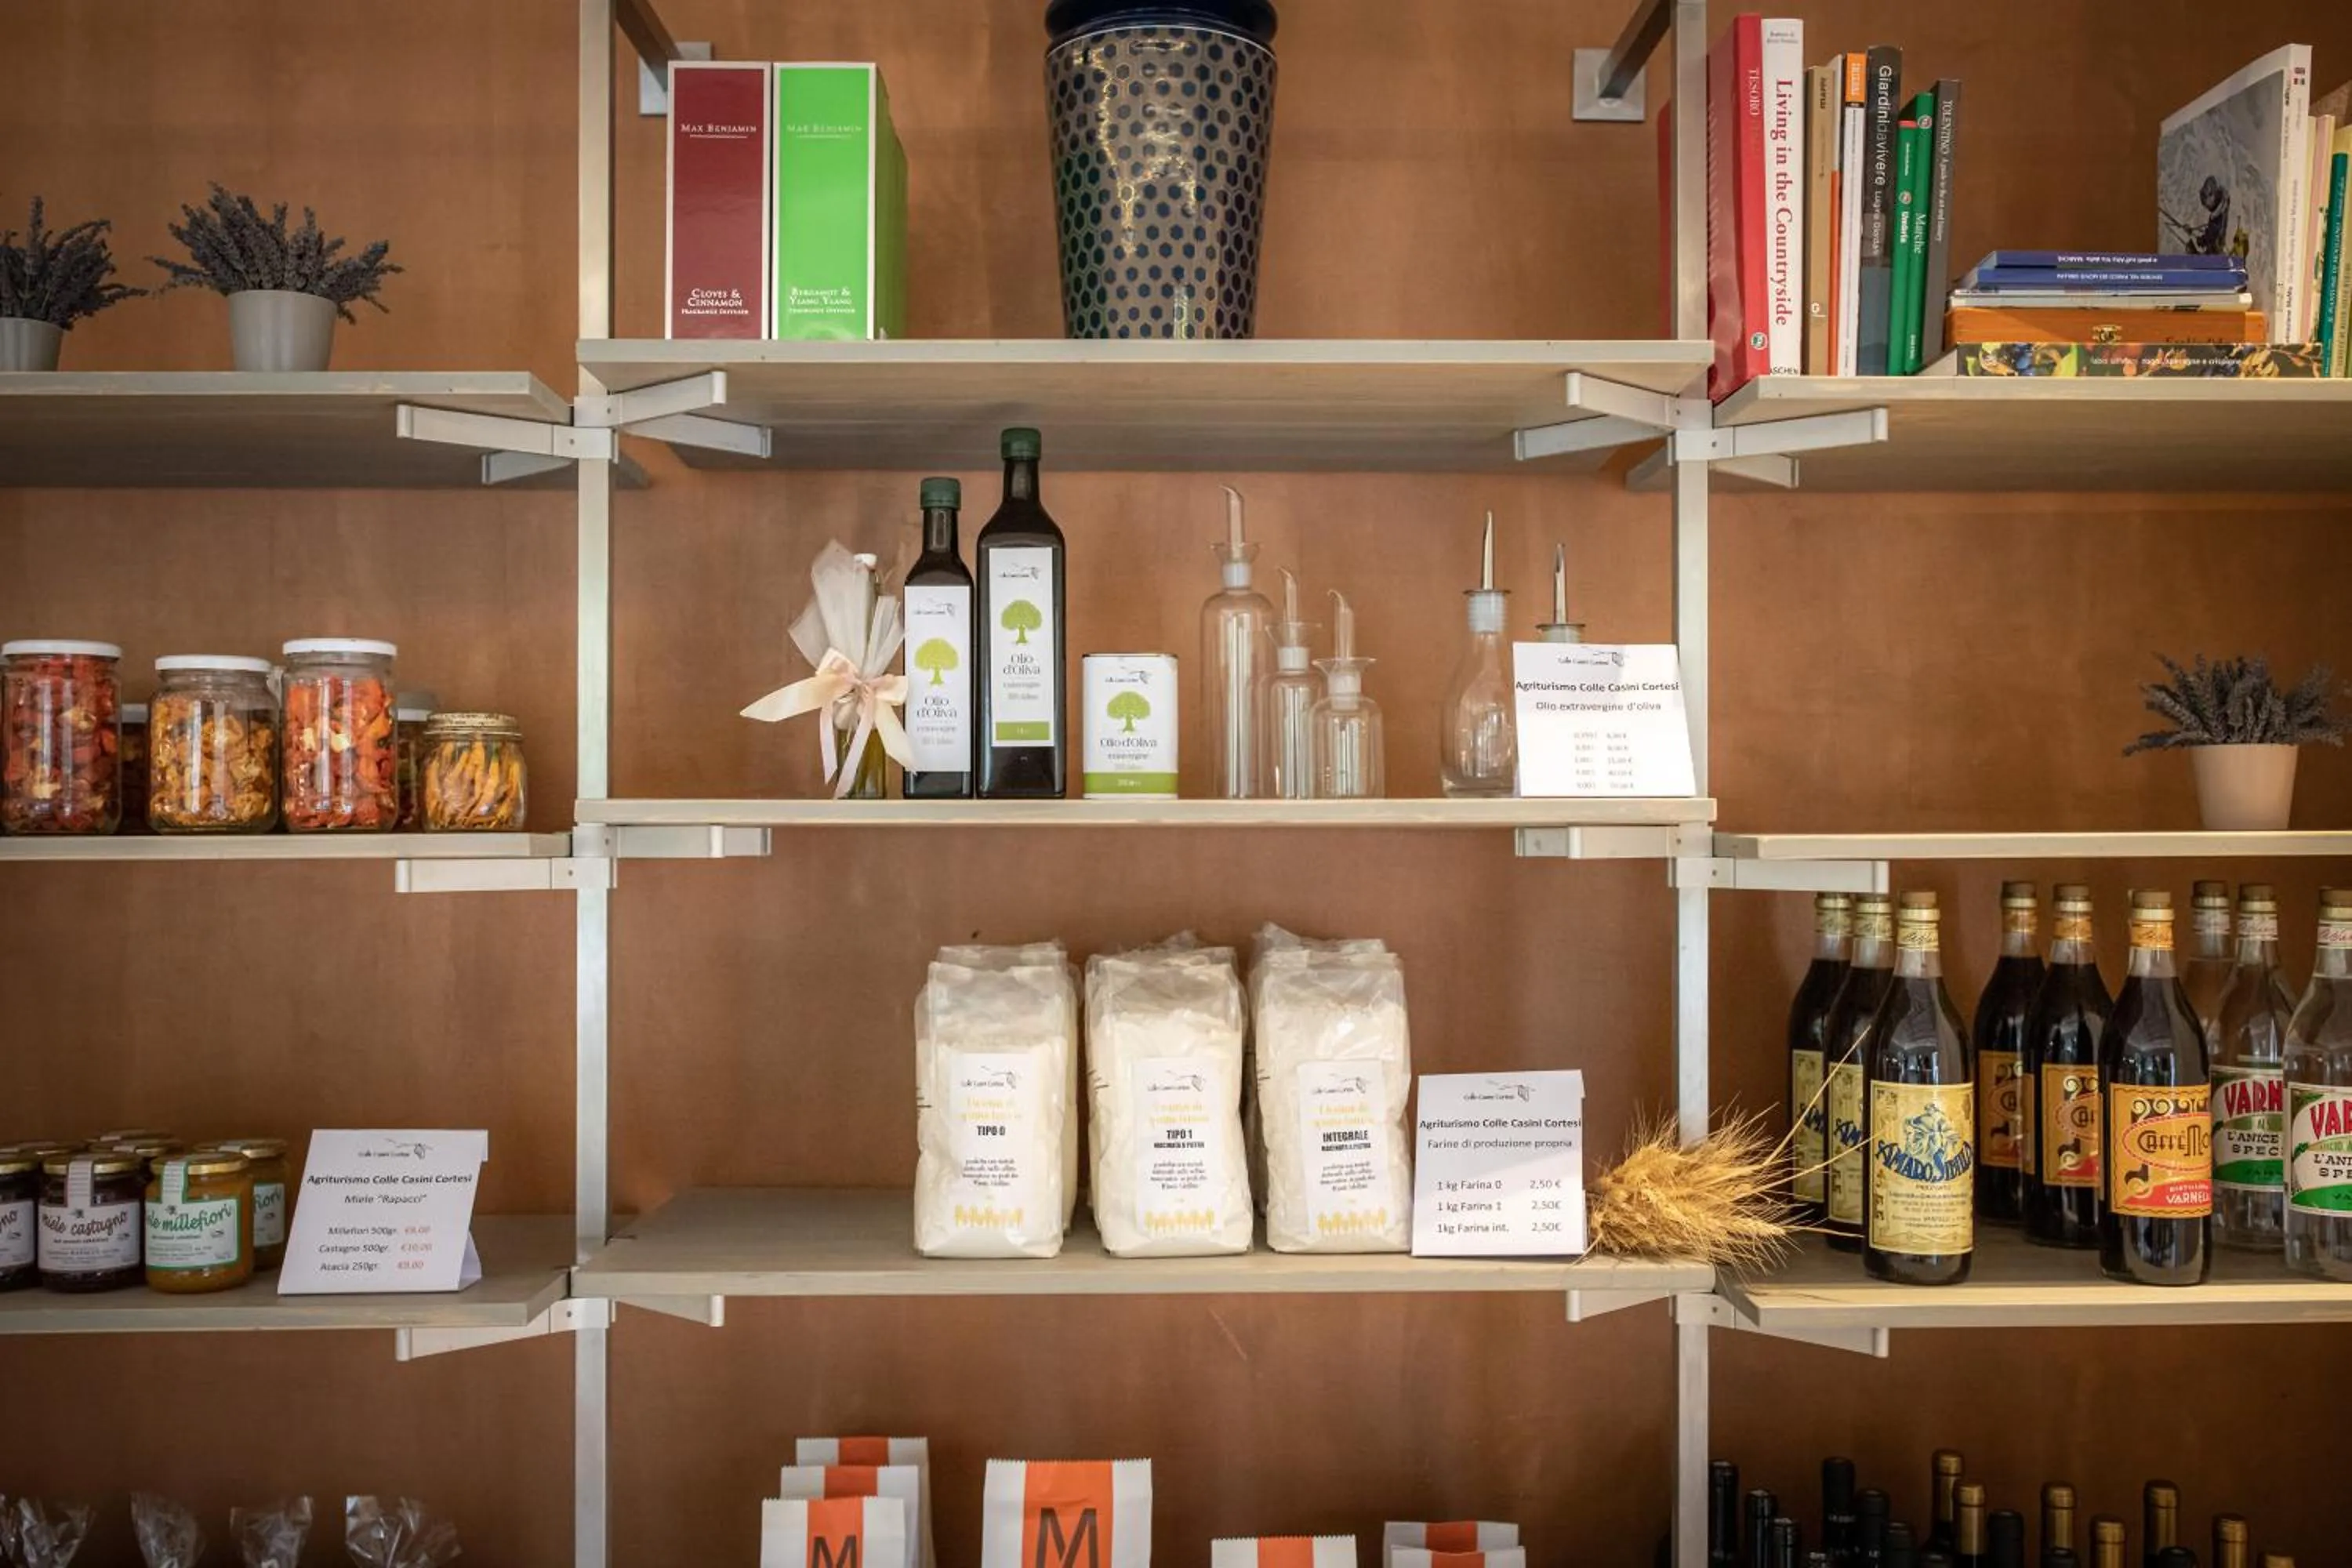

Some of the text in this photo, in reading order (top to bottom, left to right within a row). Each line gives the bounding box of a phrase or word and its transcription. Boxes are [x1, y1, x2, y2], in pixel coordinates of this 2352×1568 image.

[1748, 68, 1760, 116] TESORO
[681, 124, 757, 132] MAX BENJAMIN
[1769, 80, 1793, 326] Living in the Countryside
[1900, 211, 1910, 244] Umbria
[1913, 213, 1926, 254] Marche
[691, 289, 740, 298] CLOVES &
[688, 298, 742, 307] CINNAMON
[1011, 654, 1034, 665] Olio
[1002, 665, 1040, 676] d'Oliva
[1515, 681, 1679, 692] Agriturismo Colle Casini Cortesi
[924, 695, 950, 706] Olio
[916, 706, 958, 718] d'Oliva
[1536, 702, 1661, 712] Olio extravergine d'oliva
[1419, 1118, 1581, 1129] Agriturismo Colle Casini Cortesi
[977, 1125, 997, 1136] TIPO
[1167, 1130, 1192, 1140] TIPO 1
[1323, 1130, 1368, 1142] INTEGRALE
[2227, 1131, 2278, 1144] L'ANICE
[1428, 1138, 1573, 1150] Farine di produzione propria
[307, 1174, 472, 1185] Agriturismo Colle Casini Cortesi
[1555, 1180, 1562, 1189] €
[1437, 1181, 1443, 1190] 1
[1446, 1181, 1457, 1192] kg
[1461, 1181, 1492, 1189] Farina
[344, 1194, 373, 1203] Miele
[1437, 1202, 1502, 1213] 1 kg Farina 1
[71, 1210, 128, 1236] castagno
[162, 1203, 232, 1233] millefiori
[327, 1225, 369, 1235] Millefiori
[1437, 1224, 1454, 1234] 1kg
[1457, 1224, 1489, 1232] Farina
[318, 1244, 361, 1254] Castagno
[320, 1262, 349, 1271] Acacia
[1036, 1507, 1098, 1568] M
[811, 1535, 858, 1568] M
